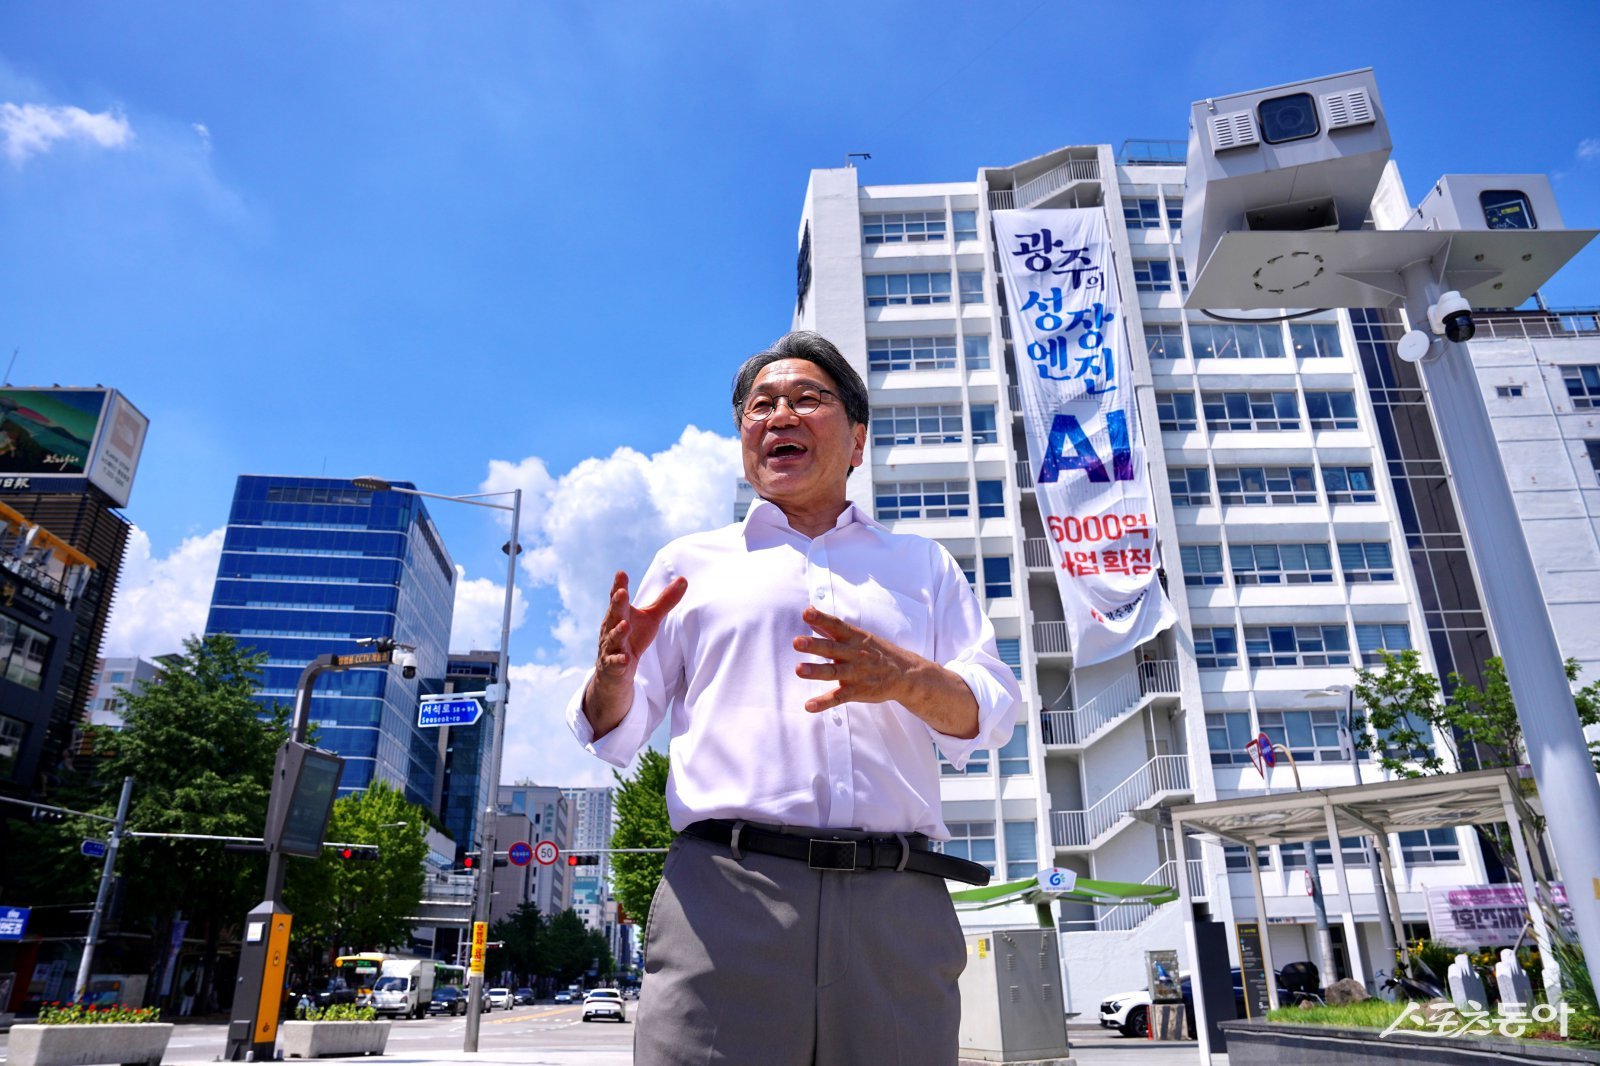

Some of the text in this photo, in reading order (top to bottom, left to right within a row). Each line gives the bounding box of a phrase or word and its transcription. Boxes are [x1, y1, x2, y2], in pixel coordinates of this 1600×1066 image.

[1012, 228, 1104, 291] 광주의
[1020, 287, 1114, 349] 성장
[1027, 336, 1118, 394] 엔진
[1038, 410, 1134, 483] AI
[1047, 514, 1149, 543] 6000억
[1101, 548, 1152, 576] 확정
[355, 653, 370, 663] CCTV
[421, 716, 461, 724] Seoseok-ro
[423, 704, 450, 715] 서석로
[541, 848, 553, 858] 50
